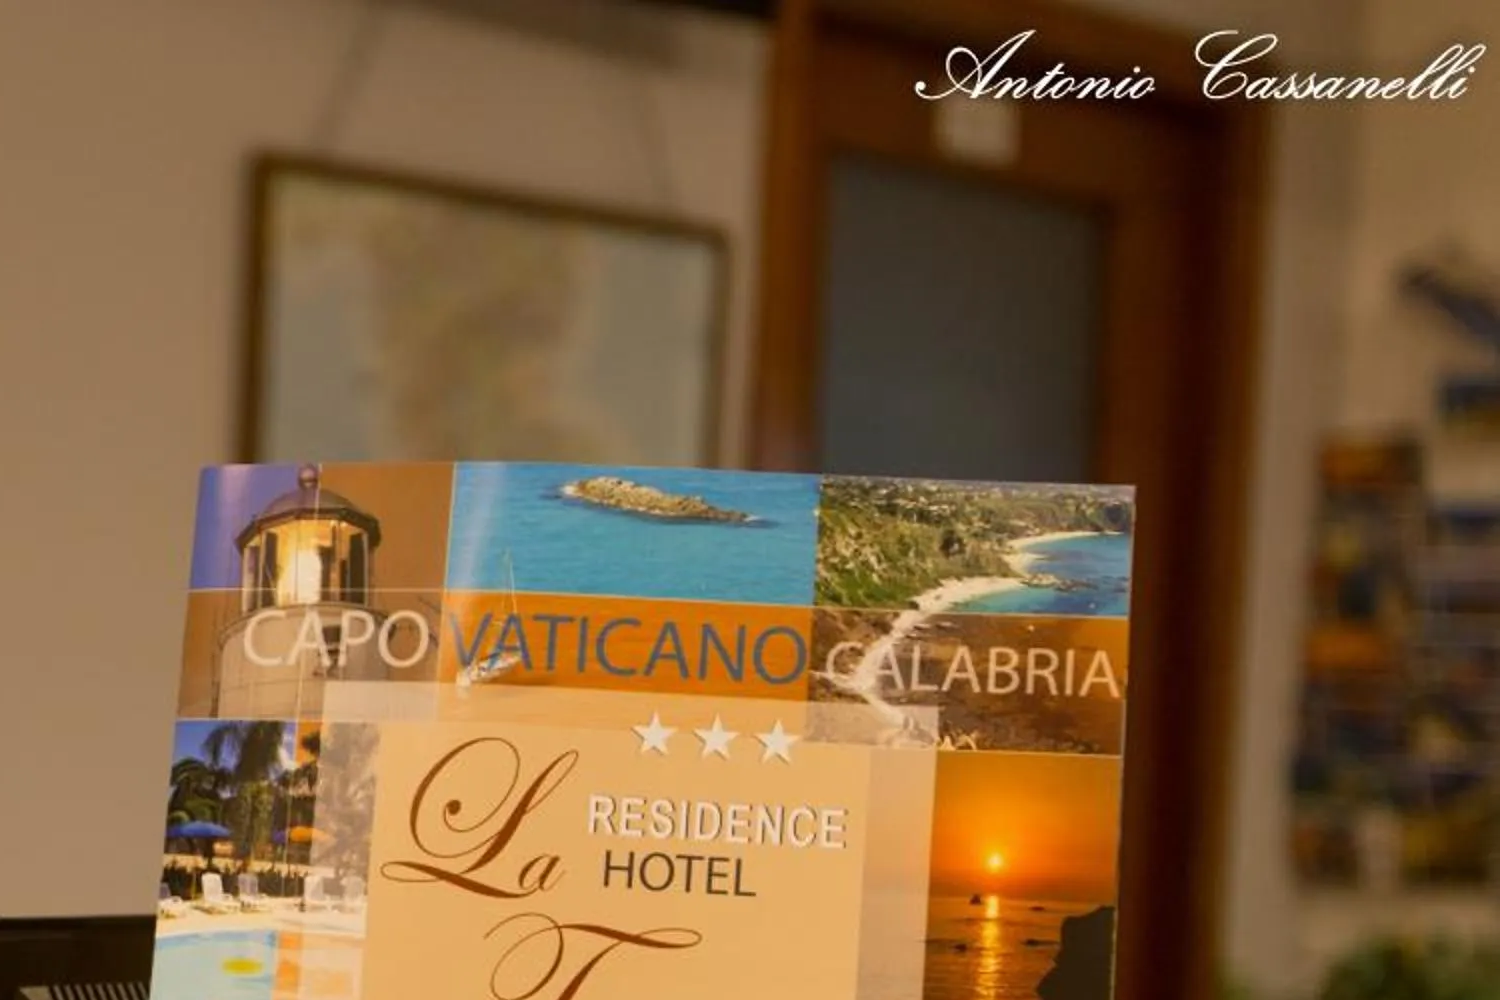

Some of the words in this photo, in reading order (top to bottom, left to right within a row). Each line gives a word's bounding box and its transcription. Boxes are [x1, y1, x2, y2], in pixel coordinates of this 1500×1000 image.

[243, 607, 431, 668] CAPO
[449, 611, 809, 685] VATICANO
[824, 640, 1120, 699] CALABRIA
[380, 736, 580, 900] La
[586, 793, 849, 849] RESIDENCE
[603, 849, 757, 898] HOTEL
